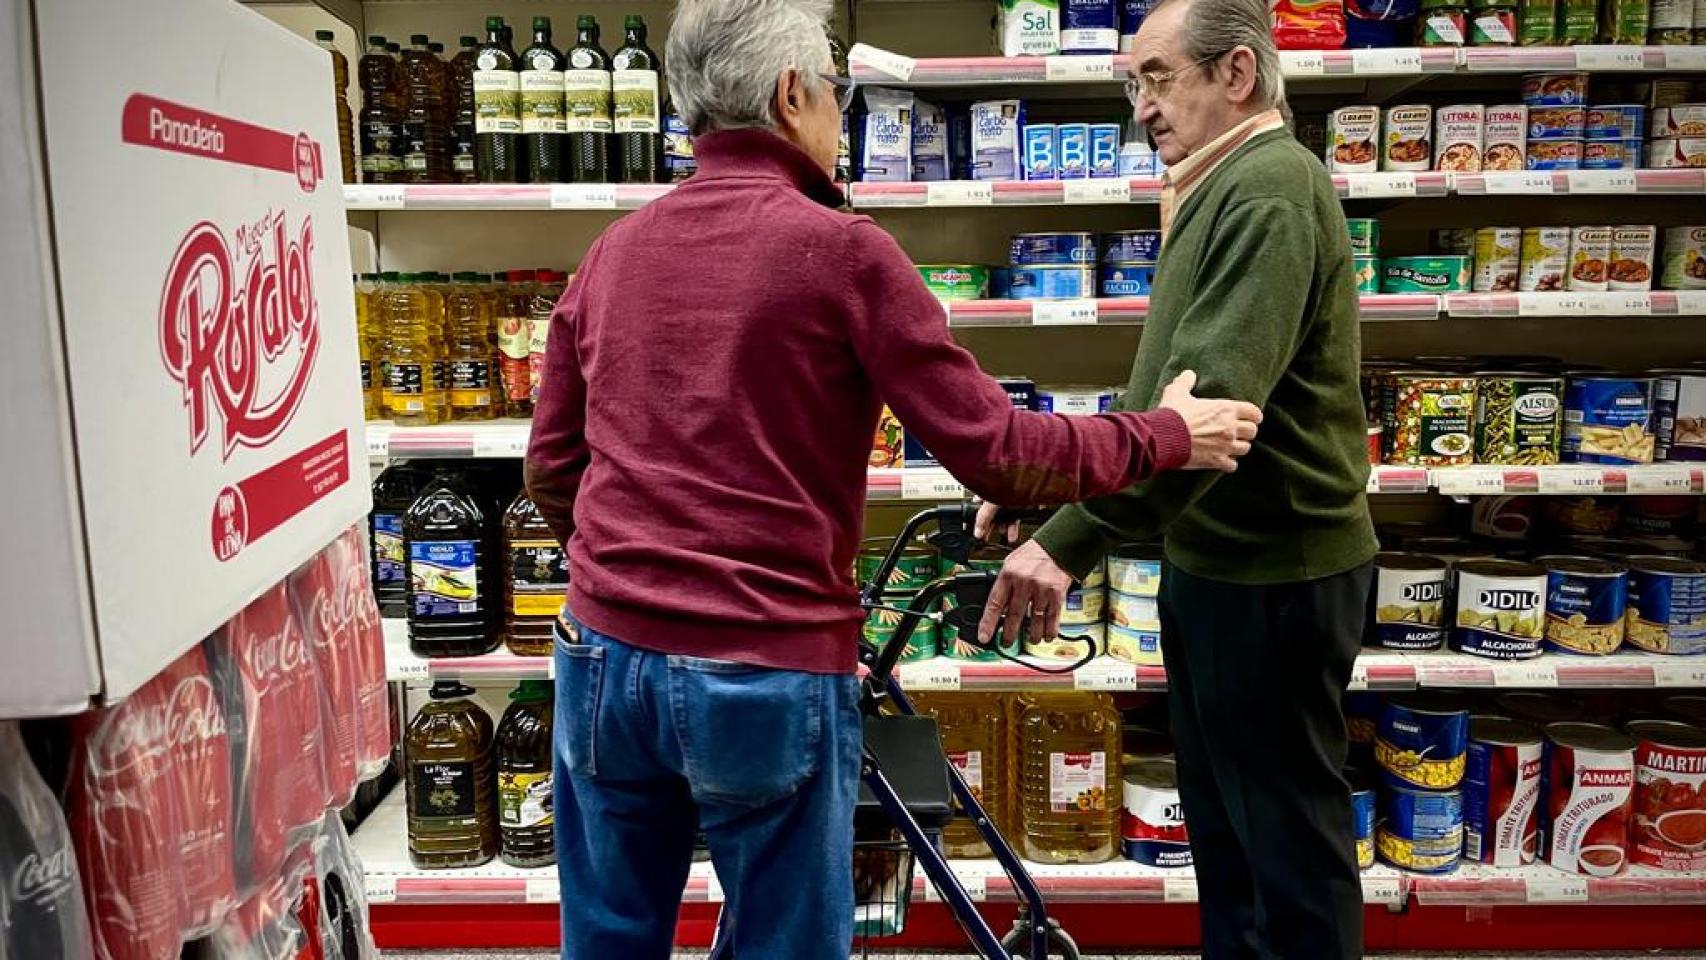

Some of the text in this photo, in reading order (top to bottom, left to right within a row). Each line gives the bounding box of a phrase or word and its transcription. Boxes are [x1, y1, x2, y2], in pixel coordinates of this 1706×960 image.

[1022, 10, 1051, 30] Sal
[876, 119, 904, 134] carbo
[979, 115, 1007, 127] carbo
[1029, 138, 1052, 167] B
[1061, 138, 1084, 167] B
[1094, 138, 1117, 167] B
[158, 209, 321, 465] Rosales
[1402, 583, 1444, 600] DIDIL
[424, 765, 434, 774] La
[1556, 792, 1615, 851] TOMATE TRITURADO
